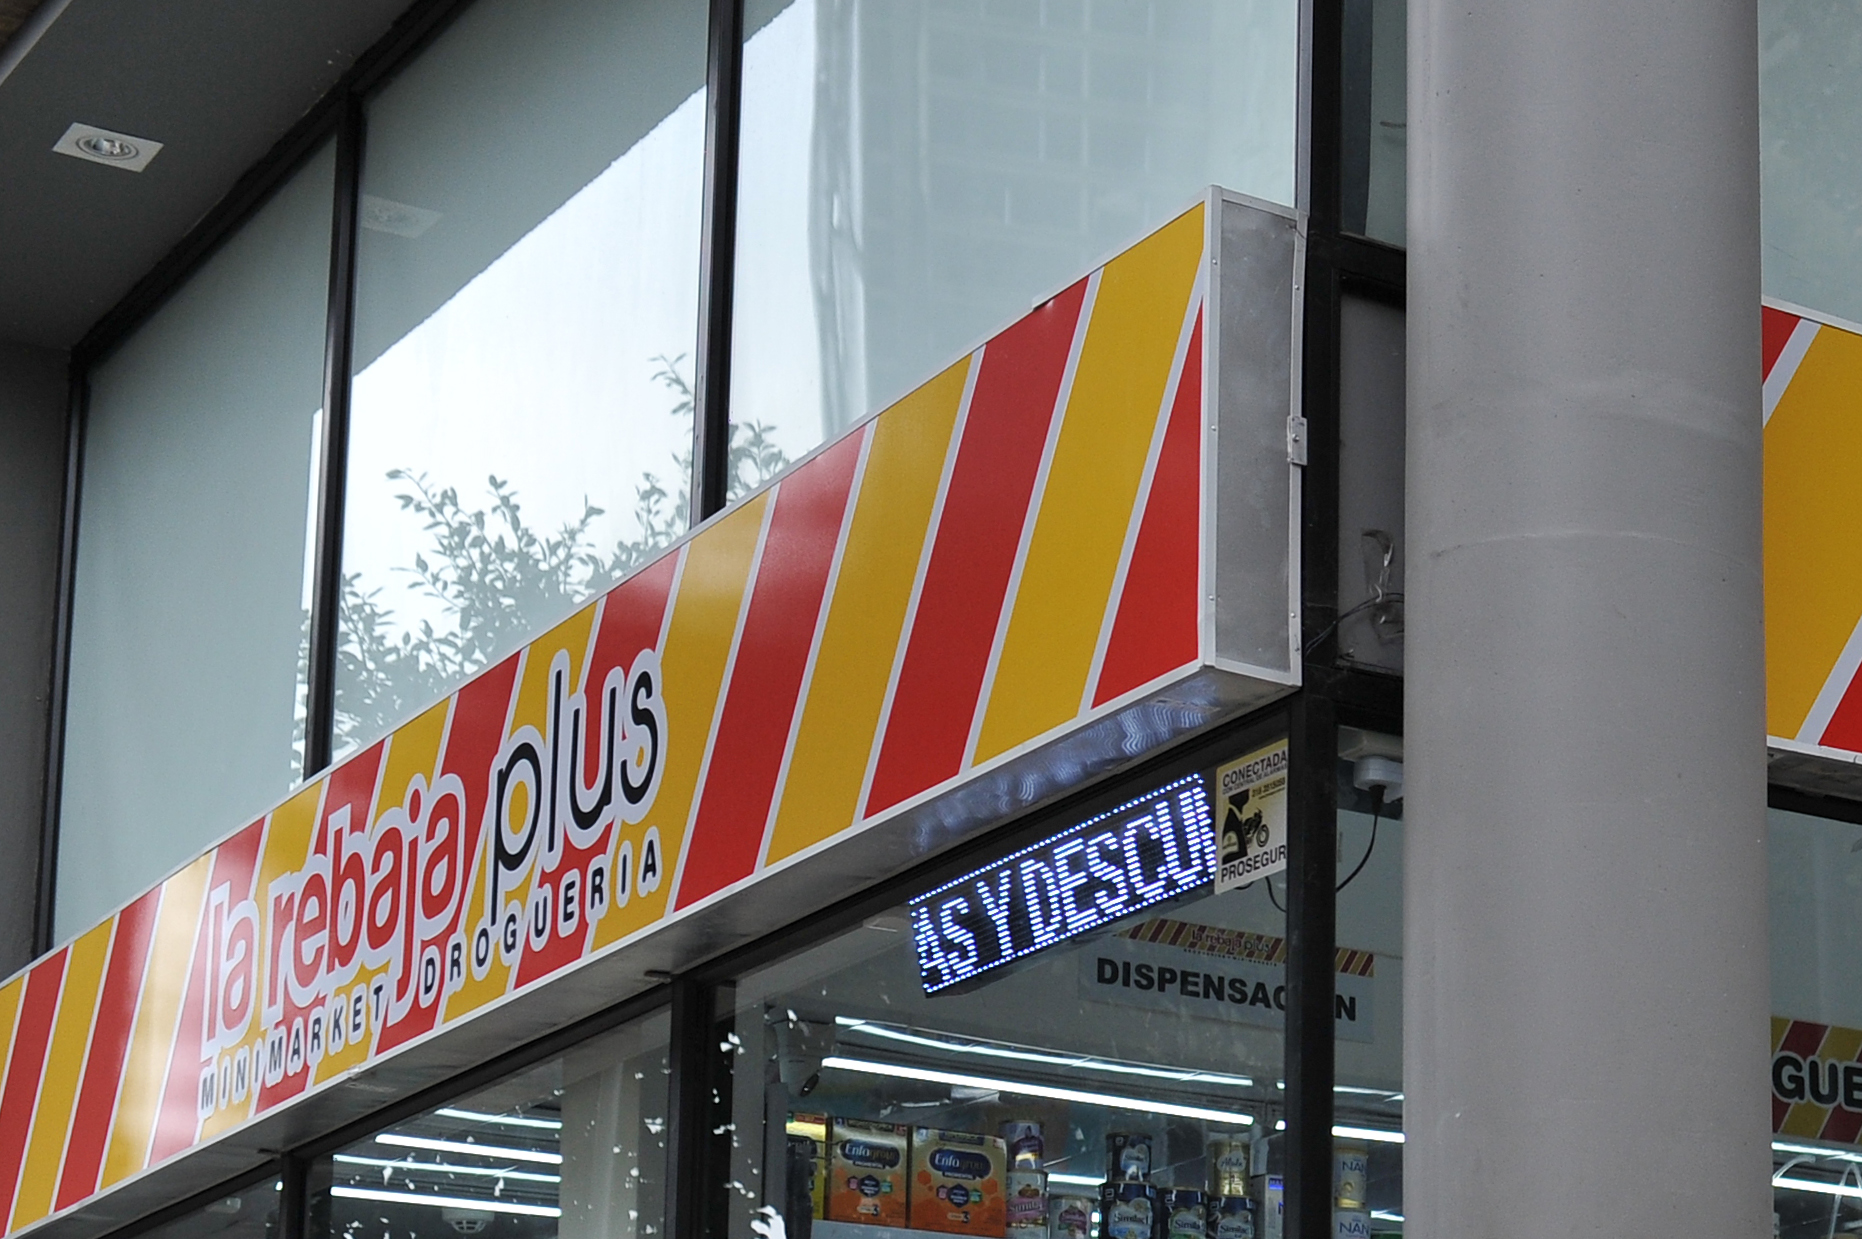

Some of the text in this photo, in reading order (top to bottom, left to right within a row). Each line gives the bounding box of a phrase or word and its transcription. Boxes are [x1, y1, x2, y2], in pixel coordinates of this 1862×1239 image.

[1222, 750, 1287, 788] CONECTADA
[207, 667, 660, 1040] la rebaja plus
[1221, 845, 1287, 883] PROSEGUR
[977, 869, 1014, 958] Y
[200, 848, 660, 1110] MINIMARKET DROGUERIA
[1097, 957, 1356, 1021] DISPENSACN
[1339, 1222, 1369, 1234] NAN
